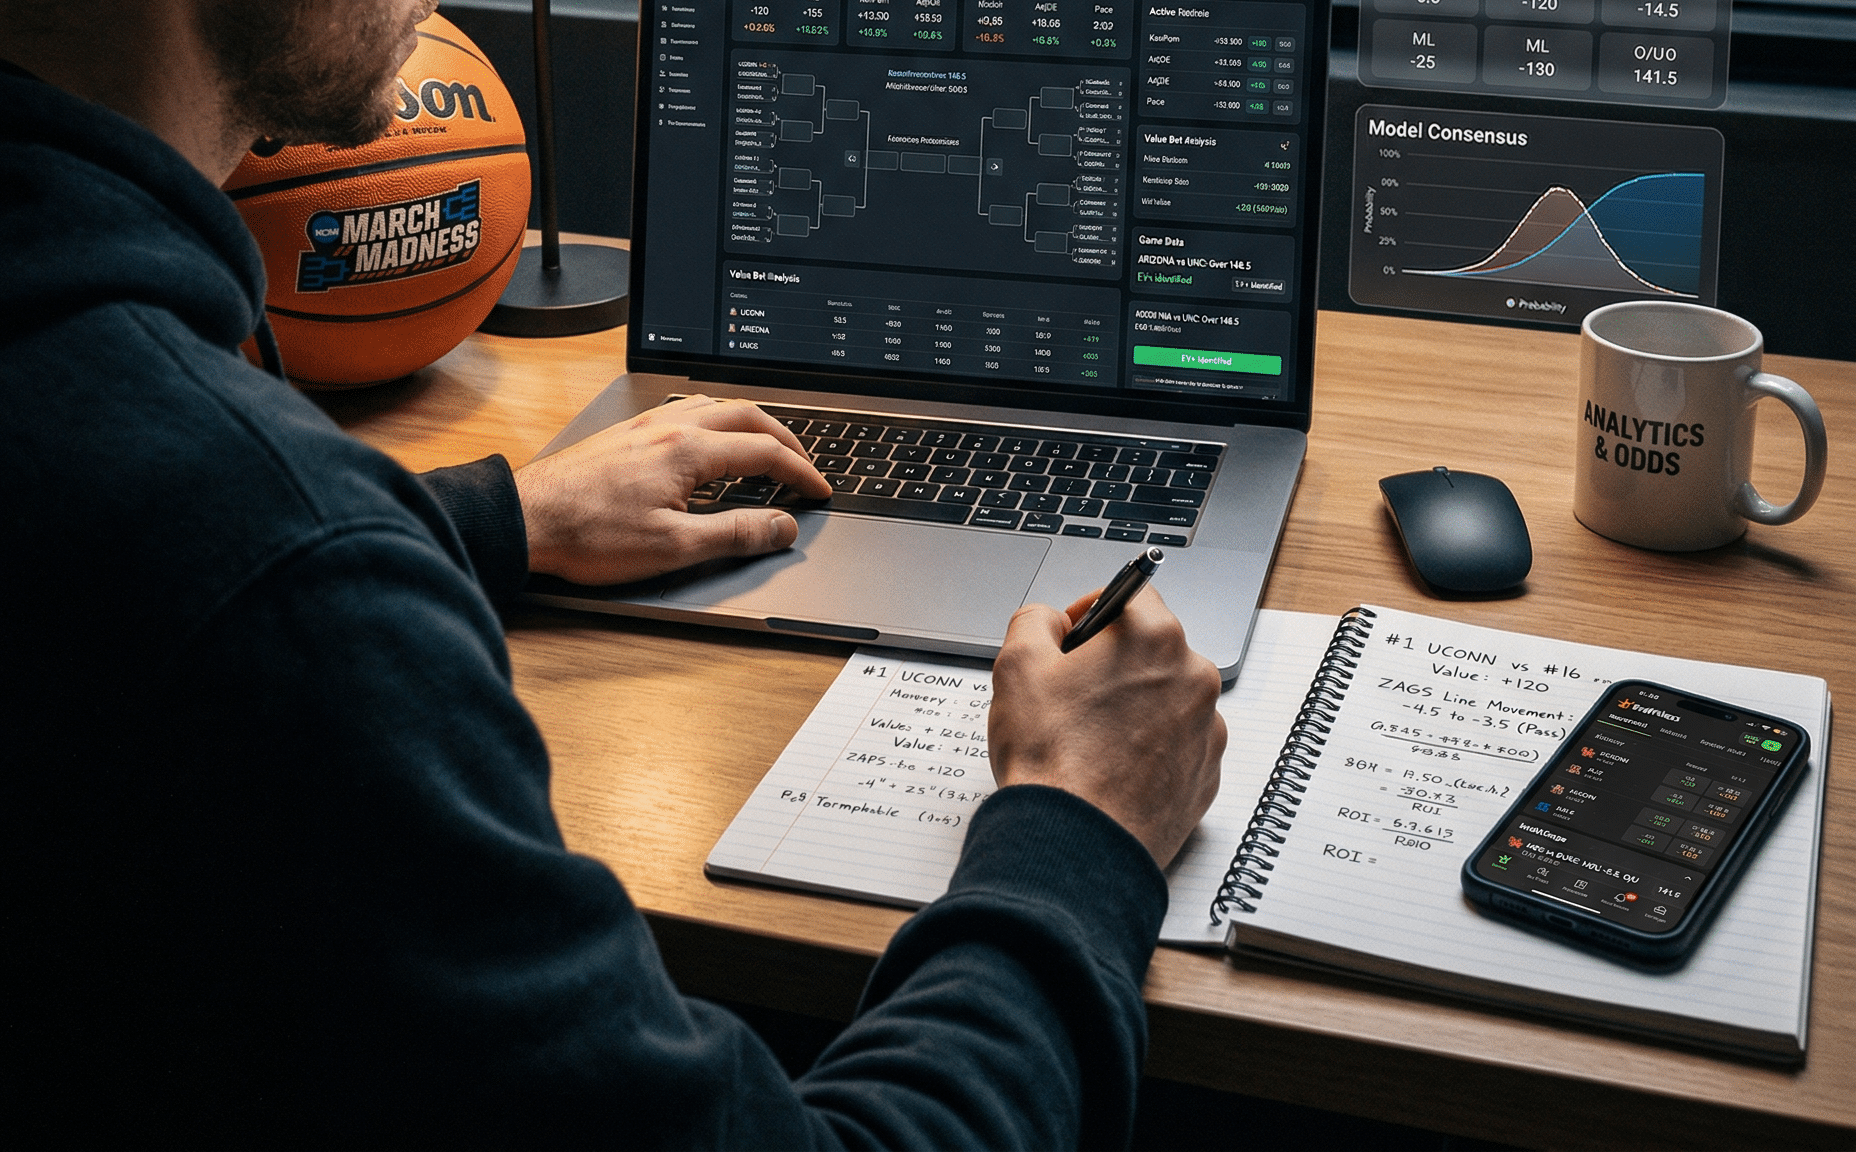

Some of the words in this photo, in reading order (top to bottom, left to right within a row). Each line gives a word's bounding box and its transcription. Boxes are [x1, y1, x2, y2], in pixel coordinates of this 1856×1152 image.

[1637, 1, 1679, 18] -14.5
[1412, 32, 1436, 47] ML
[1526, 38, 1550, 53] ML
[1410, 54, 1436, 69] -25
[1518, 61, 1555, 77] -130
[1634, 69, 1678, 86] 141.5
[1368, 119, 1423, 139] Model
[1427, 123, 1528, 147] Consensus
[1379, 148, 1401, 159] 100%
[342, 199, 440, 244] MARCH
[355, 220, 479, 272] MADNESS
[1383, 265, 1396, 275] 0%
[1584, 399, 1705, 448] ANALYTICS
[1595, 435, 1608, 463] &
[1614, 443, 1680, 476] ODDS
[1385, 633, 1414, 650] #1
[1428, 642, 1497, 666] UCONN
[1511, 661, 1529, 672] vs
[1543, 664, 1581, 680] #16
[863, 665, 888, 679] #1
[901, 670, 963, 689] UCONN
[973, 683, 988, 693] vs
[1432, 662, 1488, 682] Value:
[1502, 677, 1549, 693] +120
[1378, 677, 1433, 697] ZAGS
[1443, 690, 1477, 708] Line
[1487, 699, 1574, 723] Movement:
[1402, 703, 1442, 717] -4.5
[1449, 711, 1465, 722] to
[1472, 715, 1511, 730] -3.5
[1517, 721, 1567, 741] (Pass)
[928, 766, 965, 778] +120
[1323, 844, 1362, 864] ROI
